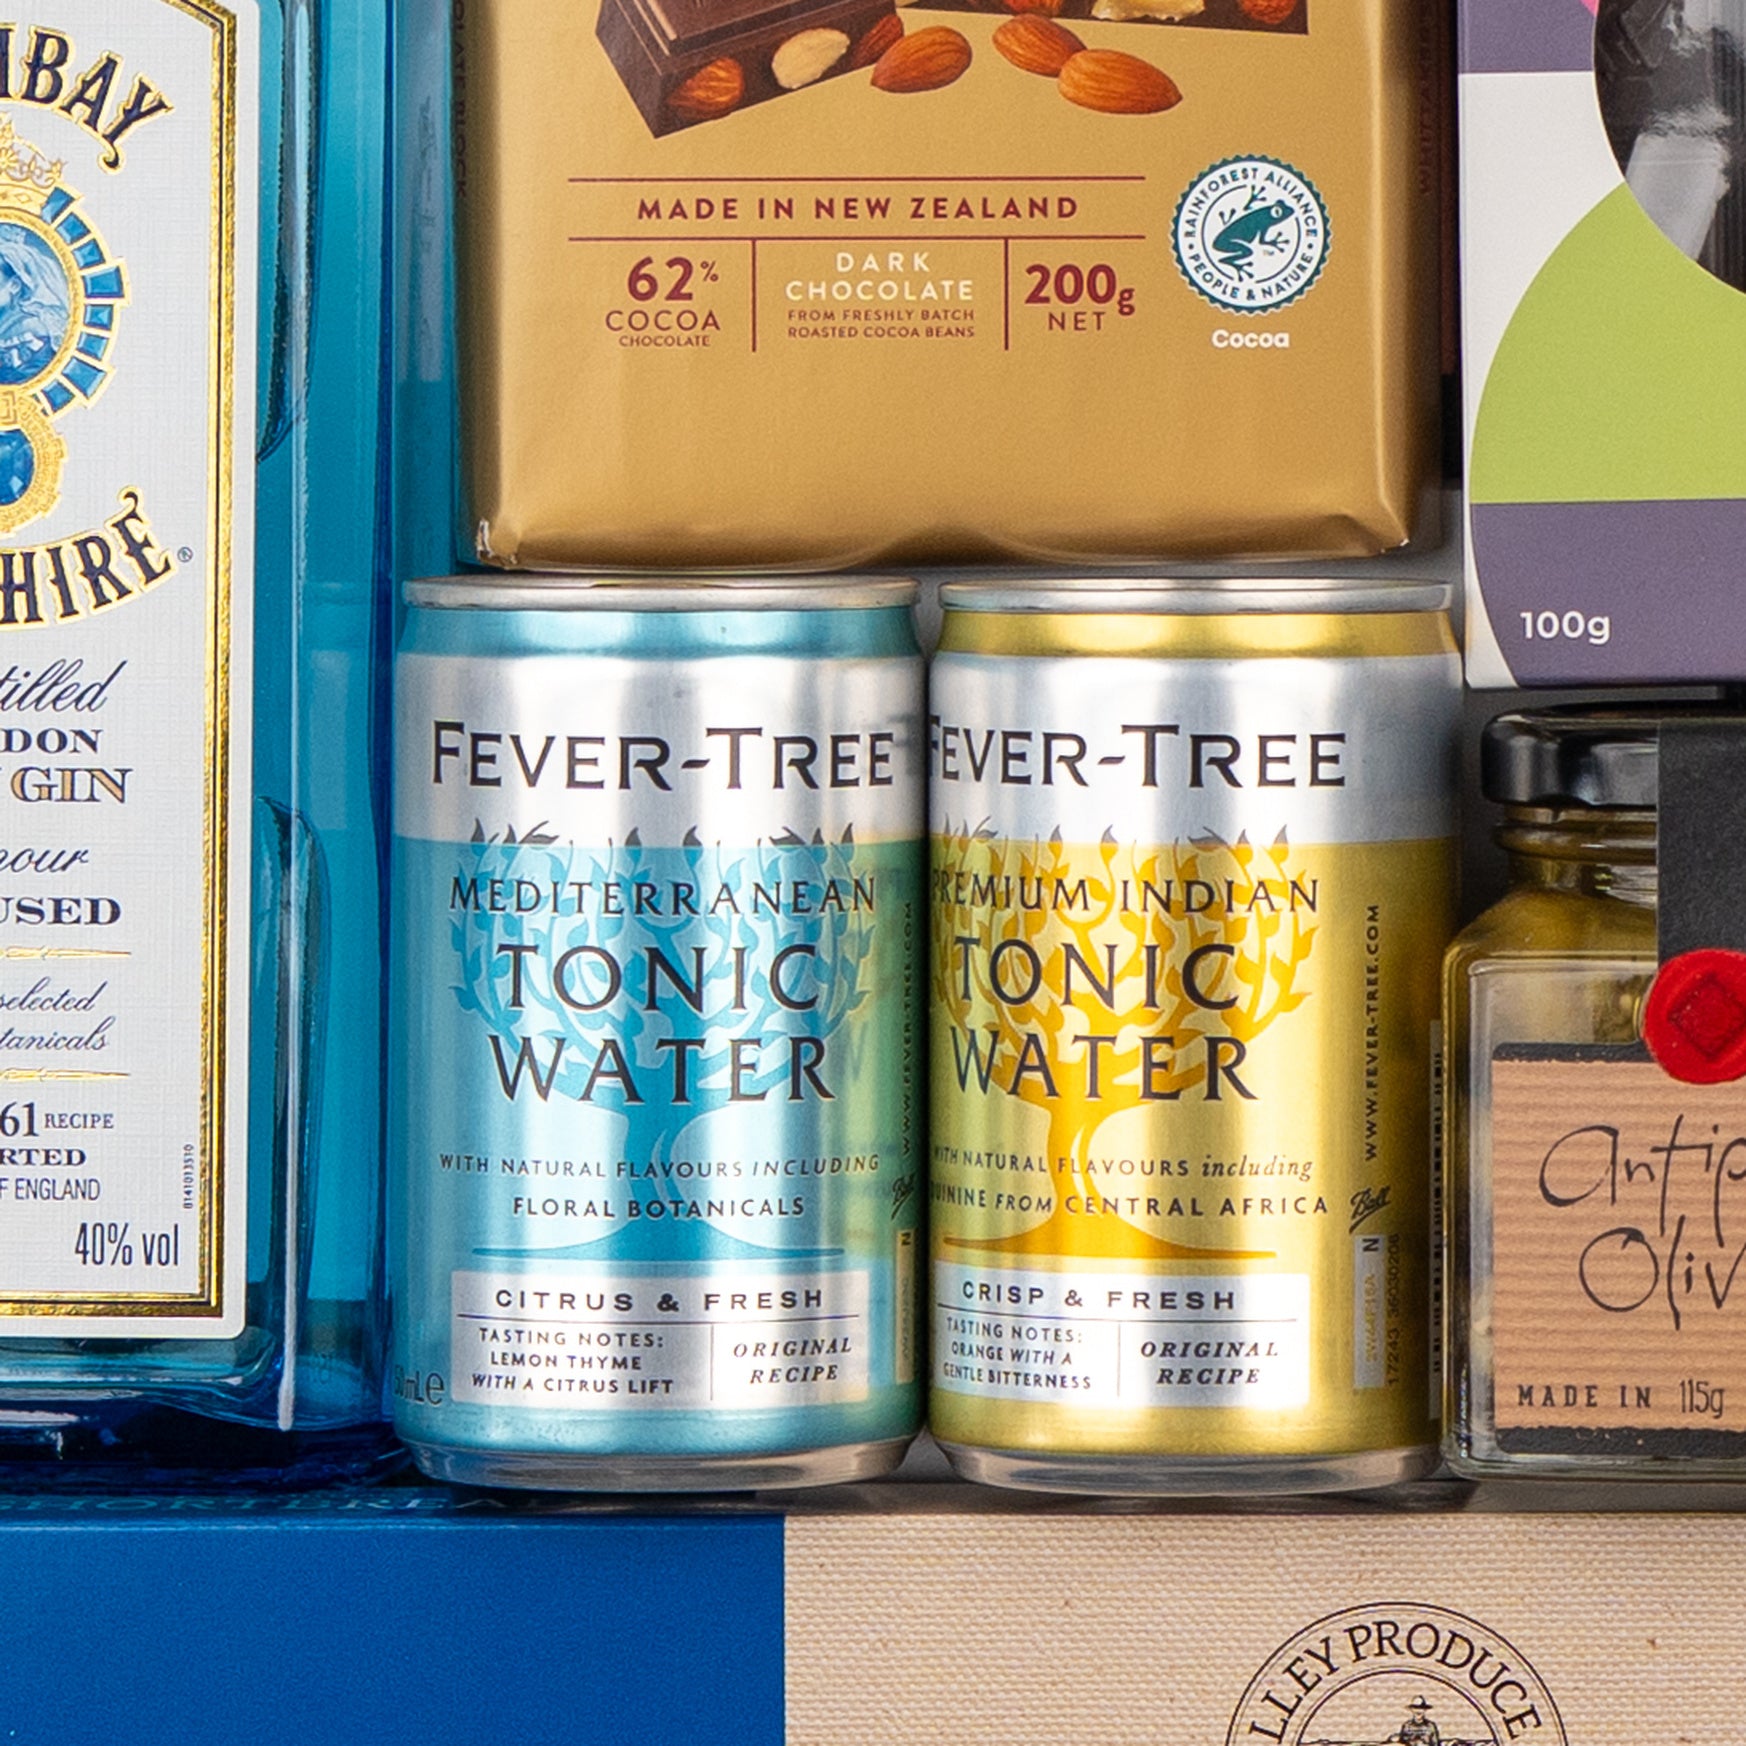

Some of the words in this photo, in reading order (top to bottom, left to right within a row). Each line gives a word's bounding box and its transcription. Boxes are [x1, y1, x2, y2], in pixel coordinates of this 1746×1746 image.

[637, 198, 739, 220] MADE
[758, 198, 794, 220] IN
[815, 197, 891, 220] NEW
[910, 197, 1078, 219] ZEALAND
[1184, 167, 1258, 238] RAINFOREST
[1264, 170, 1318, 238] ALLIANCE
[836, 252, 930, 274] DARK
[627, 256, 719, 302] 62%
[1189, 252, 1240, 300] PEOPLE
[1261, 252, 1314, 300] NATURE
[785, 279, 974, 302] CHOCOLATE
[1024, 263, 1136, 317] 200g
[605, 310, 721, 332] COCOA
[788, 309, 836, 322] FROM
[842, 309, 914, 322] FRESHLY
[921, 309, 975, 322] BATCH
[1048, 311, 1107, 332] NET
[619, 335, 711, 348] CHOCOLATE
[788, 326, 859, 339] ROASTED
[863, 326, 921, 338] COCOA
[925, 326, 975, 338] BEANS
[1211, 328, 1291, 349] Cocoa
[1519, 610, 1611, 646] 100g
[432, 719, 894, 792] FEVER-TREE
[10, 766, 134, 804] GIN
[450, 876, 876, 916] MEDITERRANEAN
[933, 867, 1090, 912] PREMIUM
[1119, 878, 1319, 914] INDIAN
[496, 943, 820, 1012] TONIC
[954, 935, 1241, 1012] TONIC
[1365, 905, 1380, 1162] WWW.FEVER-TREE.COM
[487, 1034, 836, 1103] WATER
[949, 1024, 1259, 1102] WATER
[44, 1112, 115, 1129] RECIPE
[439, 1153, 489, 1172] WITH
[501, 1158, 607, 1177] NATURAL
[616, 1160, 742, 1179] FLAVOURS
[753, 1154, 880, 1176] INCLUDING
[963, 1150, 1048, 1172] NATURAL
[1057, 1156, 1190, 1177] FLAVOURS
[1201, 1153, 1313, 1182] including
[15, 1177, 101, 1201] ENGLAND
[512, 1196, 616, 1218] FLORAL
[627, 1196, 805, 1218] BOTANICALS
[995, 1193, 1052, 1213] FROM
[1065, 1195, 1204, 1217] CENTRAL
[1219, 1195, 1328, 1217] AFRICA
[74, 1222, 134, 1267] 40%
[142, 1223, 180, 1267] vol
[495, 1289, 634, 1312] CITRUS
[656, 1292, 680, 1313] &
[703, 1289, 823, 1311] FRESH
[962, 1280, 1045, 1305] CRISP
[1064, 1289, 1083, 1308] &
[1107, 1290, 1235, 1310] FRESH
[478, 1326, 567, 1346] TASTING
[577, 1330, 664, 1348] NOTES:
[946, 1315, 1004, 1339] TASTING
[1011, 1325, 1083, 1344] NOTES:
[733, 1336, 853, 1358] ORIGINAL
[951, 1341, 1004, 1362] ORANGE
[1009, 1346, 1055, 1366] WITH
[1061, 1352, 1073, 1366] A
[1139, 1340, 1279, 1359] ORIGINAL
[490, 1350, 558, 1368] LEMON
[567, 1354, 642, 1371] THYME
[472, 1373, 516, 1391] WITH
[523, 1377, 535, 1391] A
[543, 1377, 619, 1393] CITRUS
[628, 1379, 674, 1395] LIFT
[749, 1364, 839, 1385] RECIPE
[943, 1361, 984, 1384] GENTLE
[988, 1369, 1092, 1390] BITTERNESS
[1156, 1366, 1260, 1386] RECIPE
[1516, 1384, 1599, 1409] MADE
[1619, 1384, 1652, 1409] IN
[1678, 1378, 1726, 1419] 115g
[1343, 1619, 1543, 1741] PRODUCE
